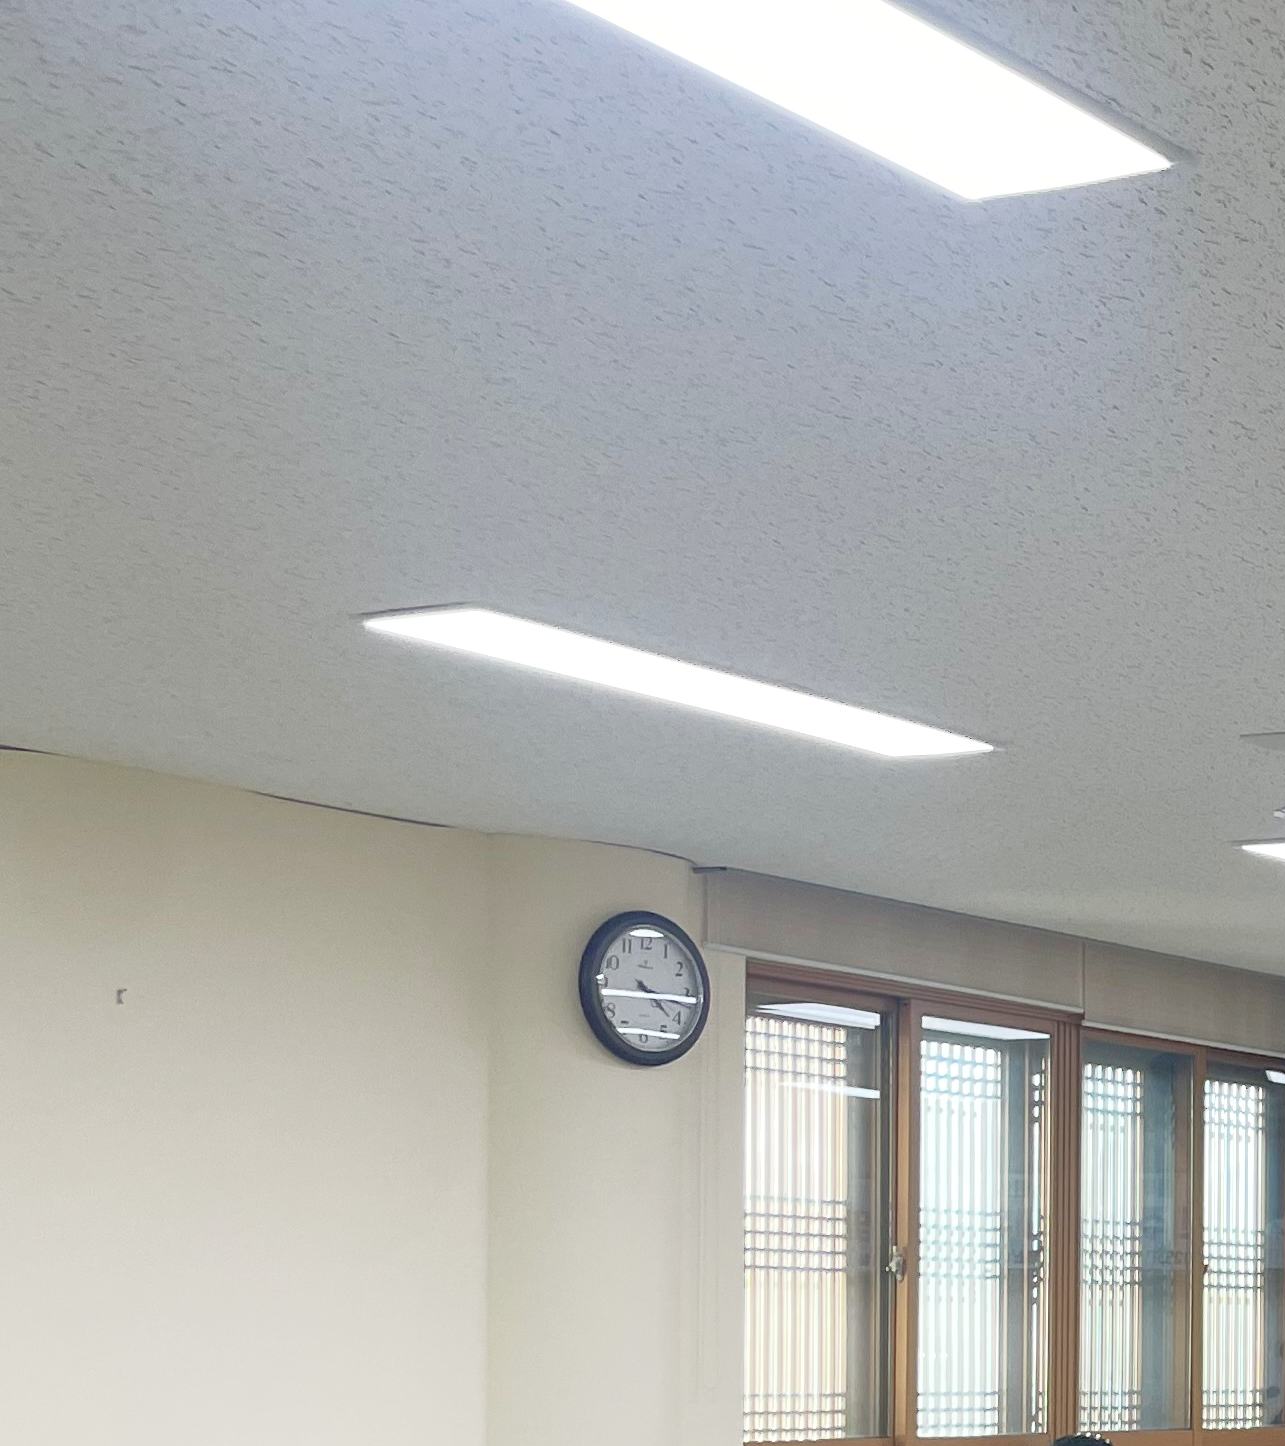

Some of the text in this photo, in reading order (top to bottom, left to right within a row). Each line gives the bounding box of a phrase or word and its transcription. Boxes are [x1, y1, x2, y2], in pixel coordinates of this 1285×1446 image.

[621, 938, 632, 954] 11
[663, 943, 669, 959] 1
[605, 955, 620, 971] 10
[675, 961, 684, 977] 2
[605, 1003, 616, 1019] 8
[672, 1010, 681, 1026] 4
